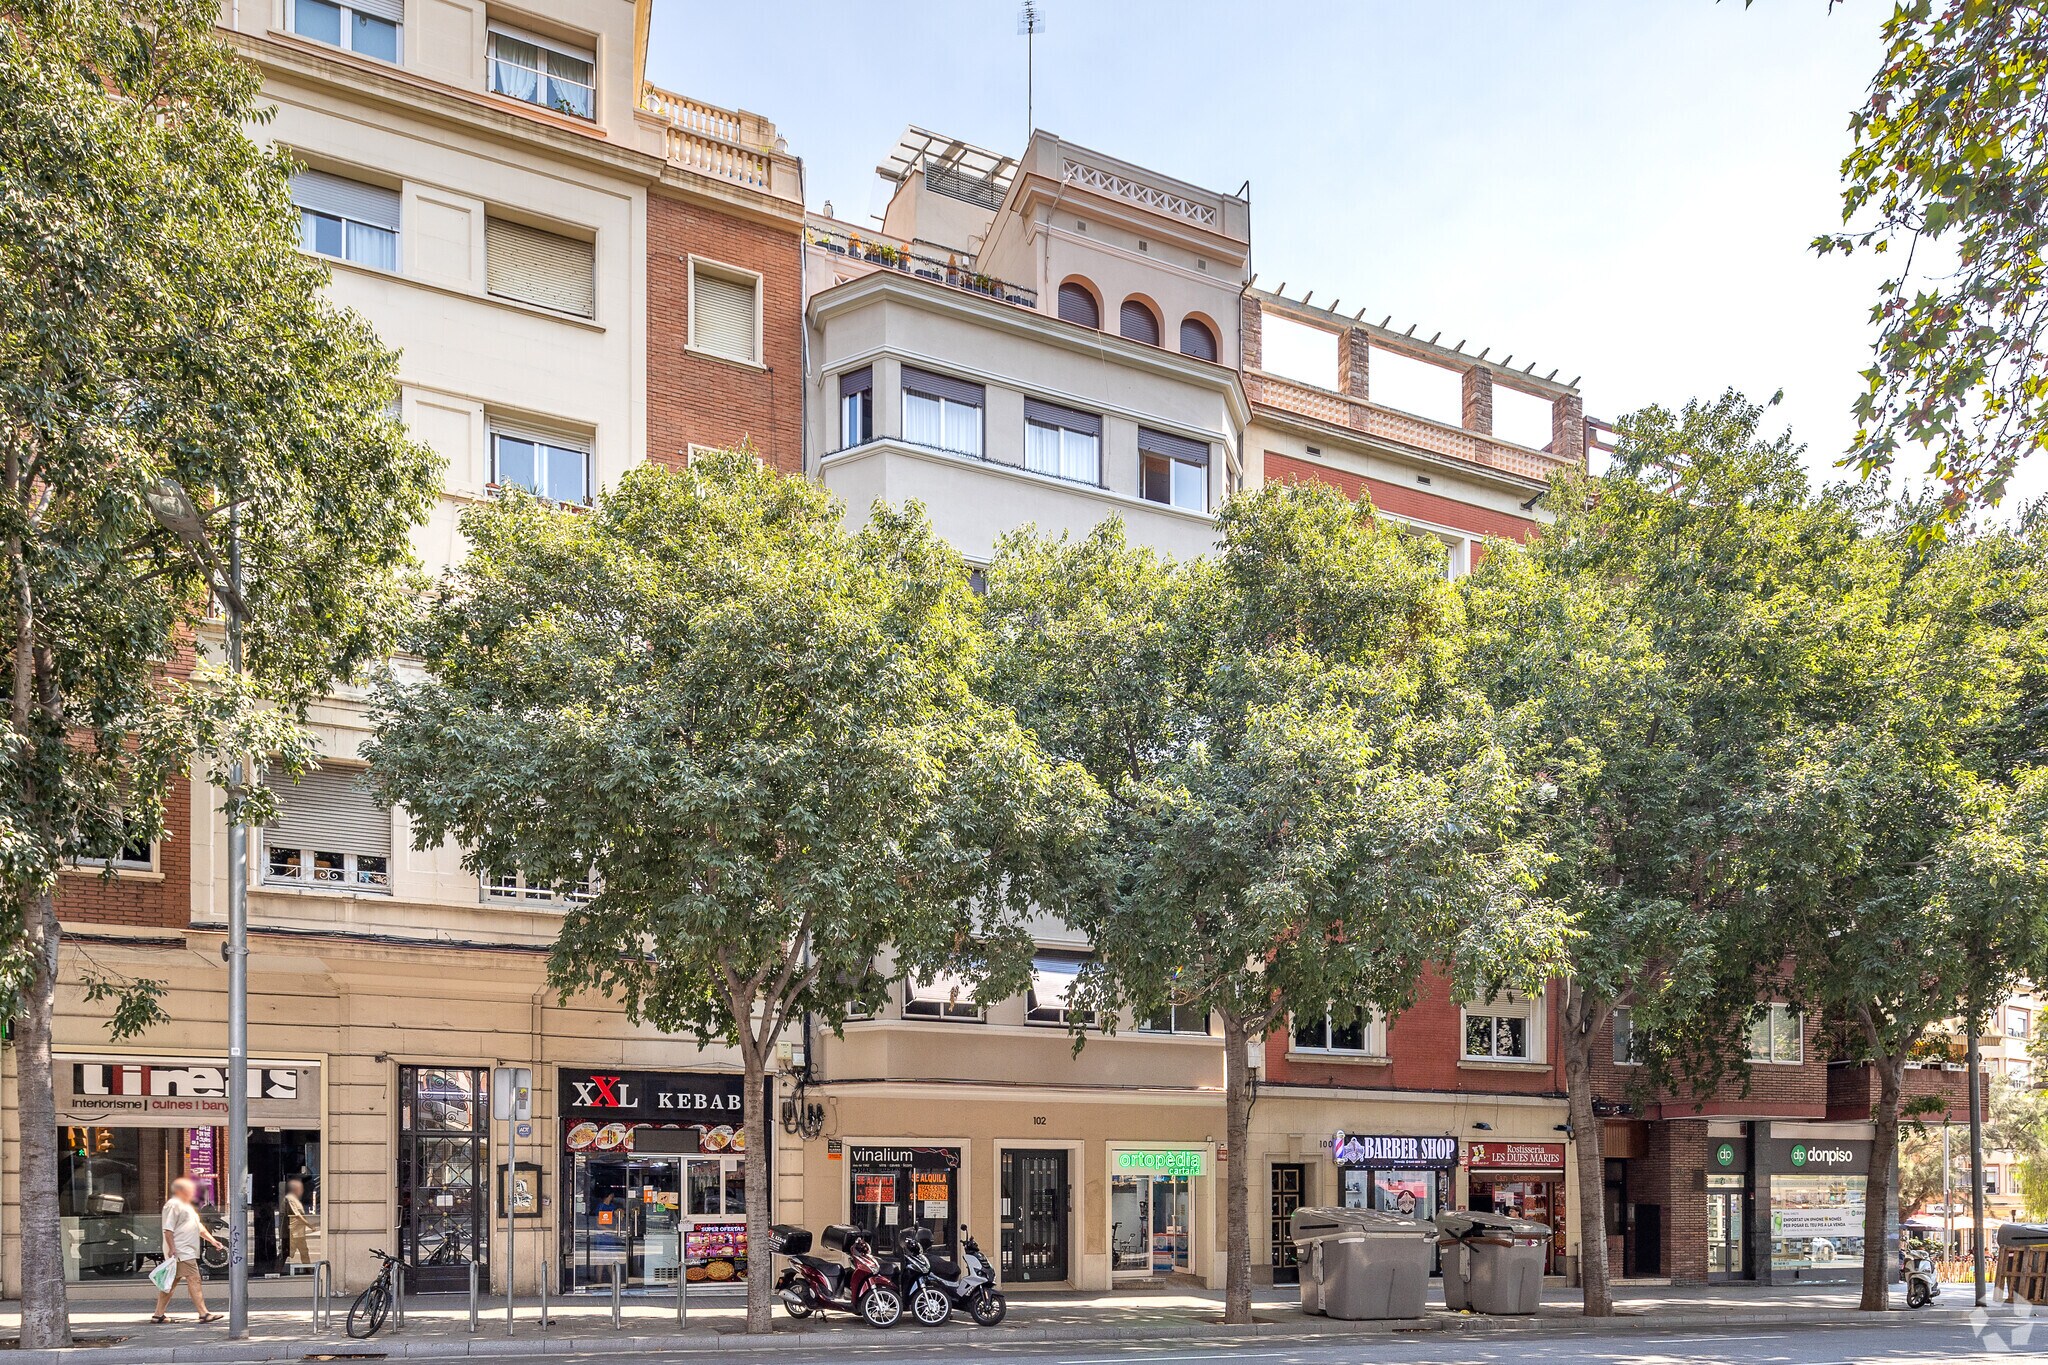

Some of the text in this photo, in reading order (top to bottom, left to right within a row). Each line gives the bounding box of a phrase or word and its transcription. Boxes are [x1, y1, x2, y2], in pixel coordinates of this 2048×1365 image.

[572, 1075, 742, 1110] XXL KEBAB
[72, 1099, 141, 1109] interiorisme
[153, 1100, 193, 1110] cuines
[1033, 1116, 1047, 1125] 102
[1319, 1140, 1333, 1148] 100
[1364, 1137, 1455, 1160] BARBER SHOP
[1507, 1144, 1545, 1154] Rostisseria
[852, 1148, 913, 1161] vinalium
[1492, 1152, 1560, 1163] LES DUES MARIES
[1719, 1148, 1732, 1162] dp
[1793, 1147, 1853, 1166] dp donpiso
[1119, 1151, 1201, 1170] ortopèdia
[857, 1176, 894, 1185] SE ALQUILA
[911, 1173, 947, 1183] SE ALQUILA
